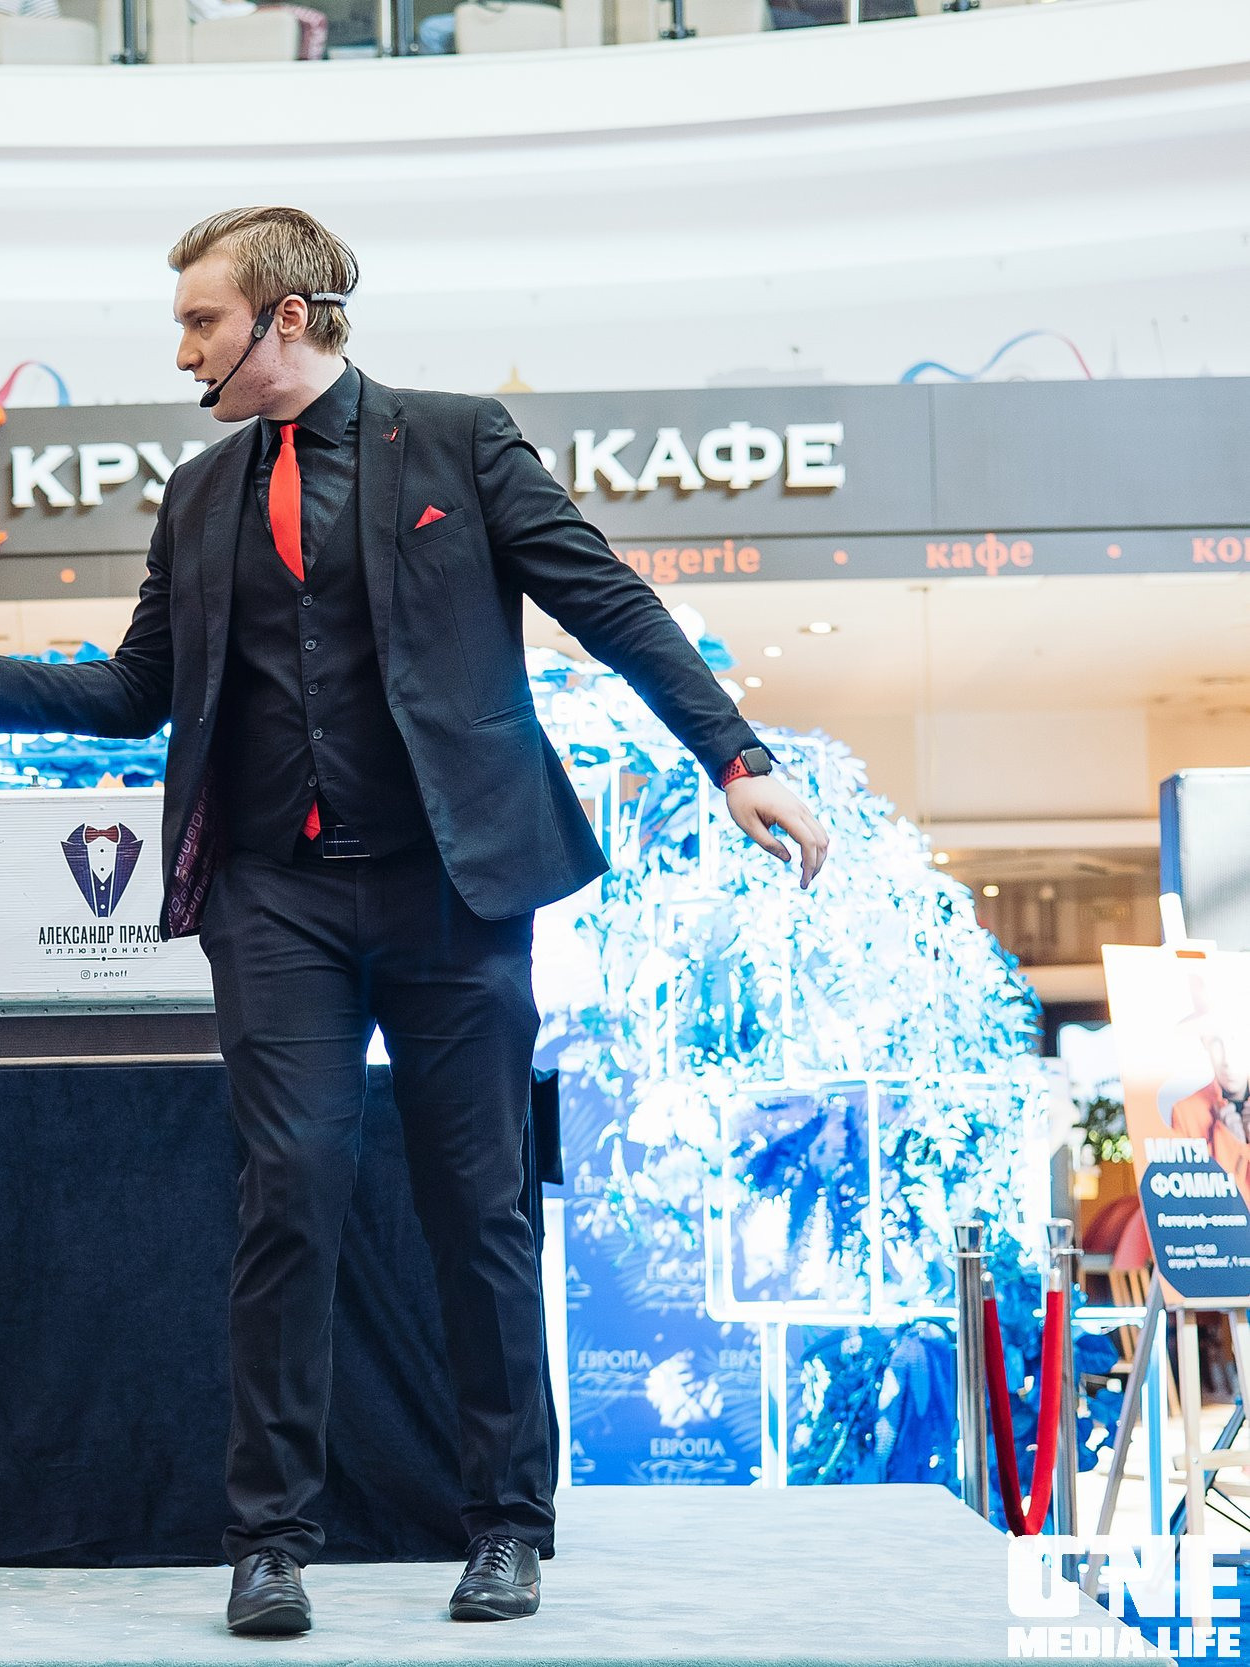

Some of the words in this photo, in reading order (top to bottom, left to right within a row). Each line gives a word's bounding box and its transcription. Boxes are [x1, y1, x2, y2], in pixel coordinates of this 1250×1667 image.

[572, 421, 846, 492] КАФЕ
[611, 539, 760, 584] ngerie
[925, 532, 1034, 576] кафе
[1191, 536, 1250, 564] ко
[38, 926, 114, 945] АЛЕКСАНДР
[119, 925, 168, 943] ПРАХО
[93, 970, 128, 979] prahoff
[1150, 1172, 1238, 1198] ФОМИН
[578, 1350, 654, 1370] ЕВРОПА
[650, 1437, 727, 1458] ЕВРОПА
